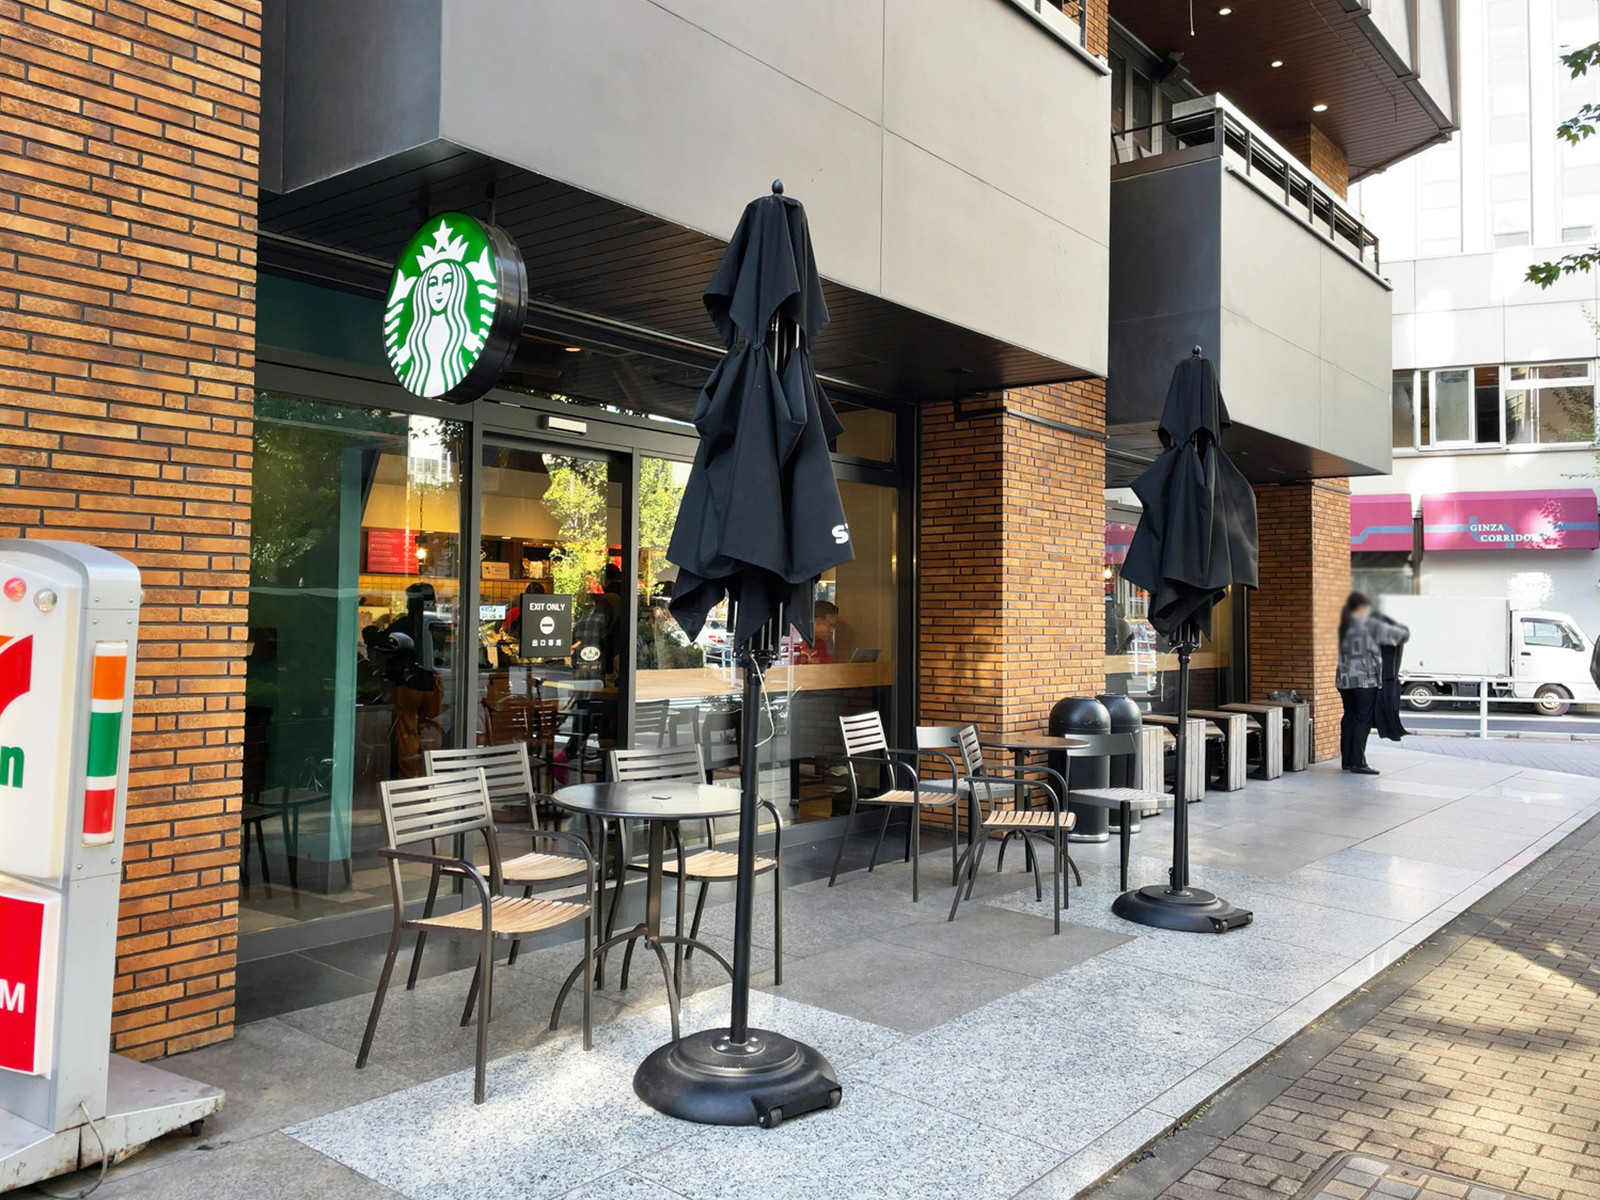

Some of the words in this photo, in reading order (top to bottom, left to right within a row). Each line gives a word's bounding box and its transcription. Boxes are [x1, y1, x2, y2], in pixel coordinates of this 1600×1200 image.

[1469, 524, 1505, 532] GINZA
[831, 522, 849, 545] S
[529, 602, 545, 611] EXIT
[546, 603, 566, 612] ONLY
